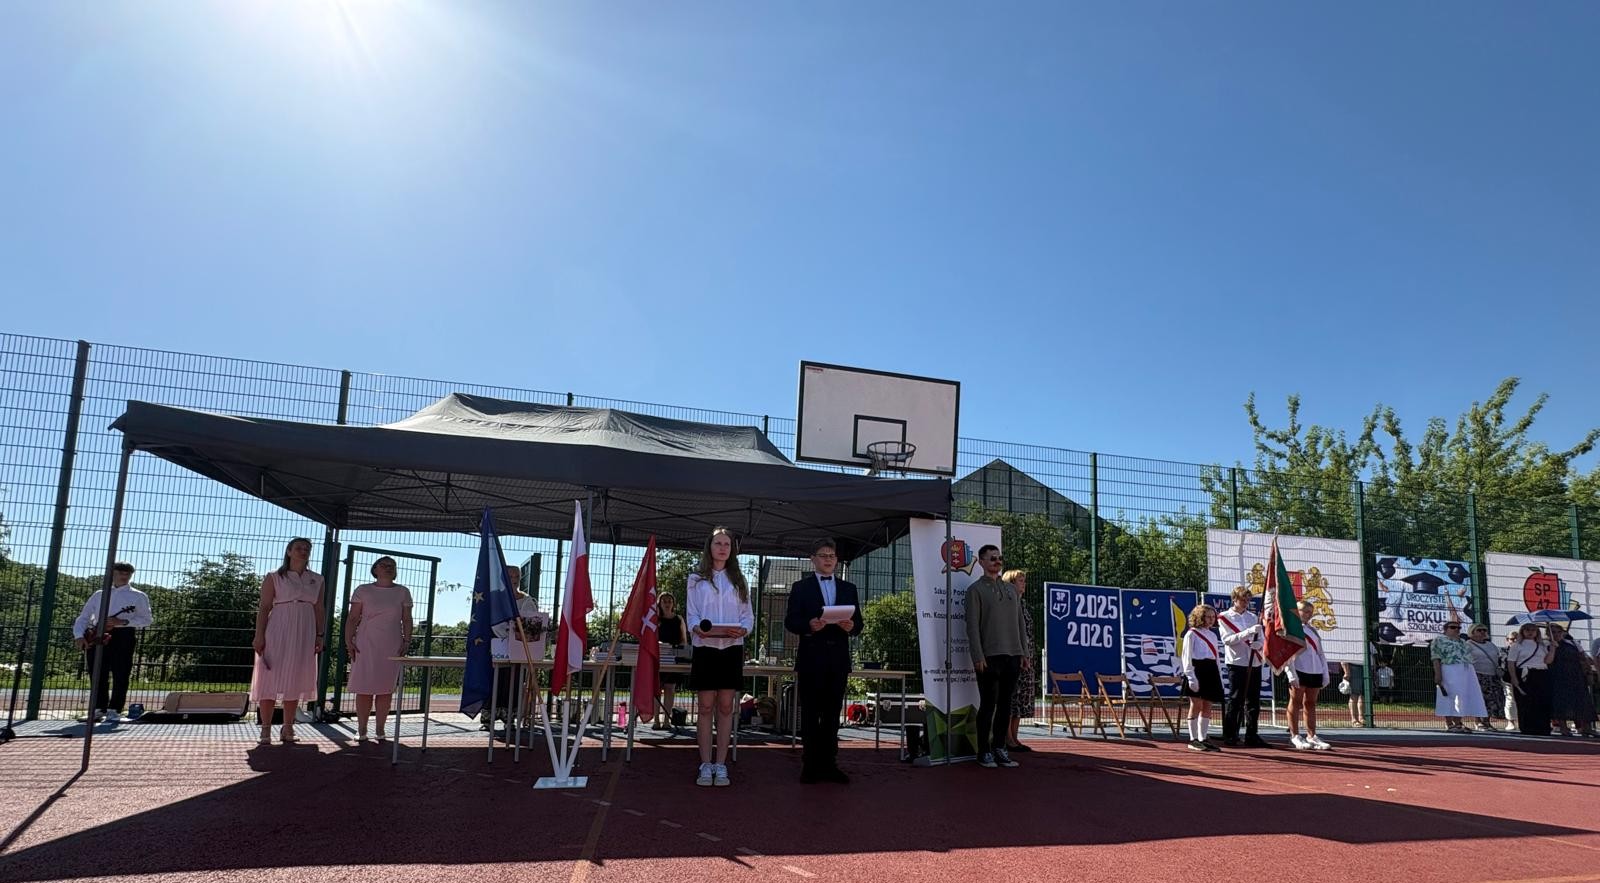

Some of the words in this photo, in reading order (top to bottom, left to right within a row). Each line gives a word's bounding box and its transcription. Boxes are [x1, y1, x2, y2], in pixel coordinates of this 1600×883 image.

[1056, 591, 1066, 601] SP
[1535, 583, 1551, 597] SP
[1053, 602, 1067, 613] 47
[1075, 593, 1118, 620] 2025
[1537, 599, 1550, 611] 47
[1407, 610, 1443, 623] ROKU
[1407, 622, 1444, 633] SZKOLNEG
[1067, 621, 1113, 648] 2026
